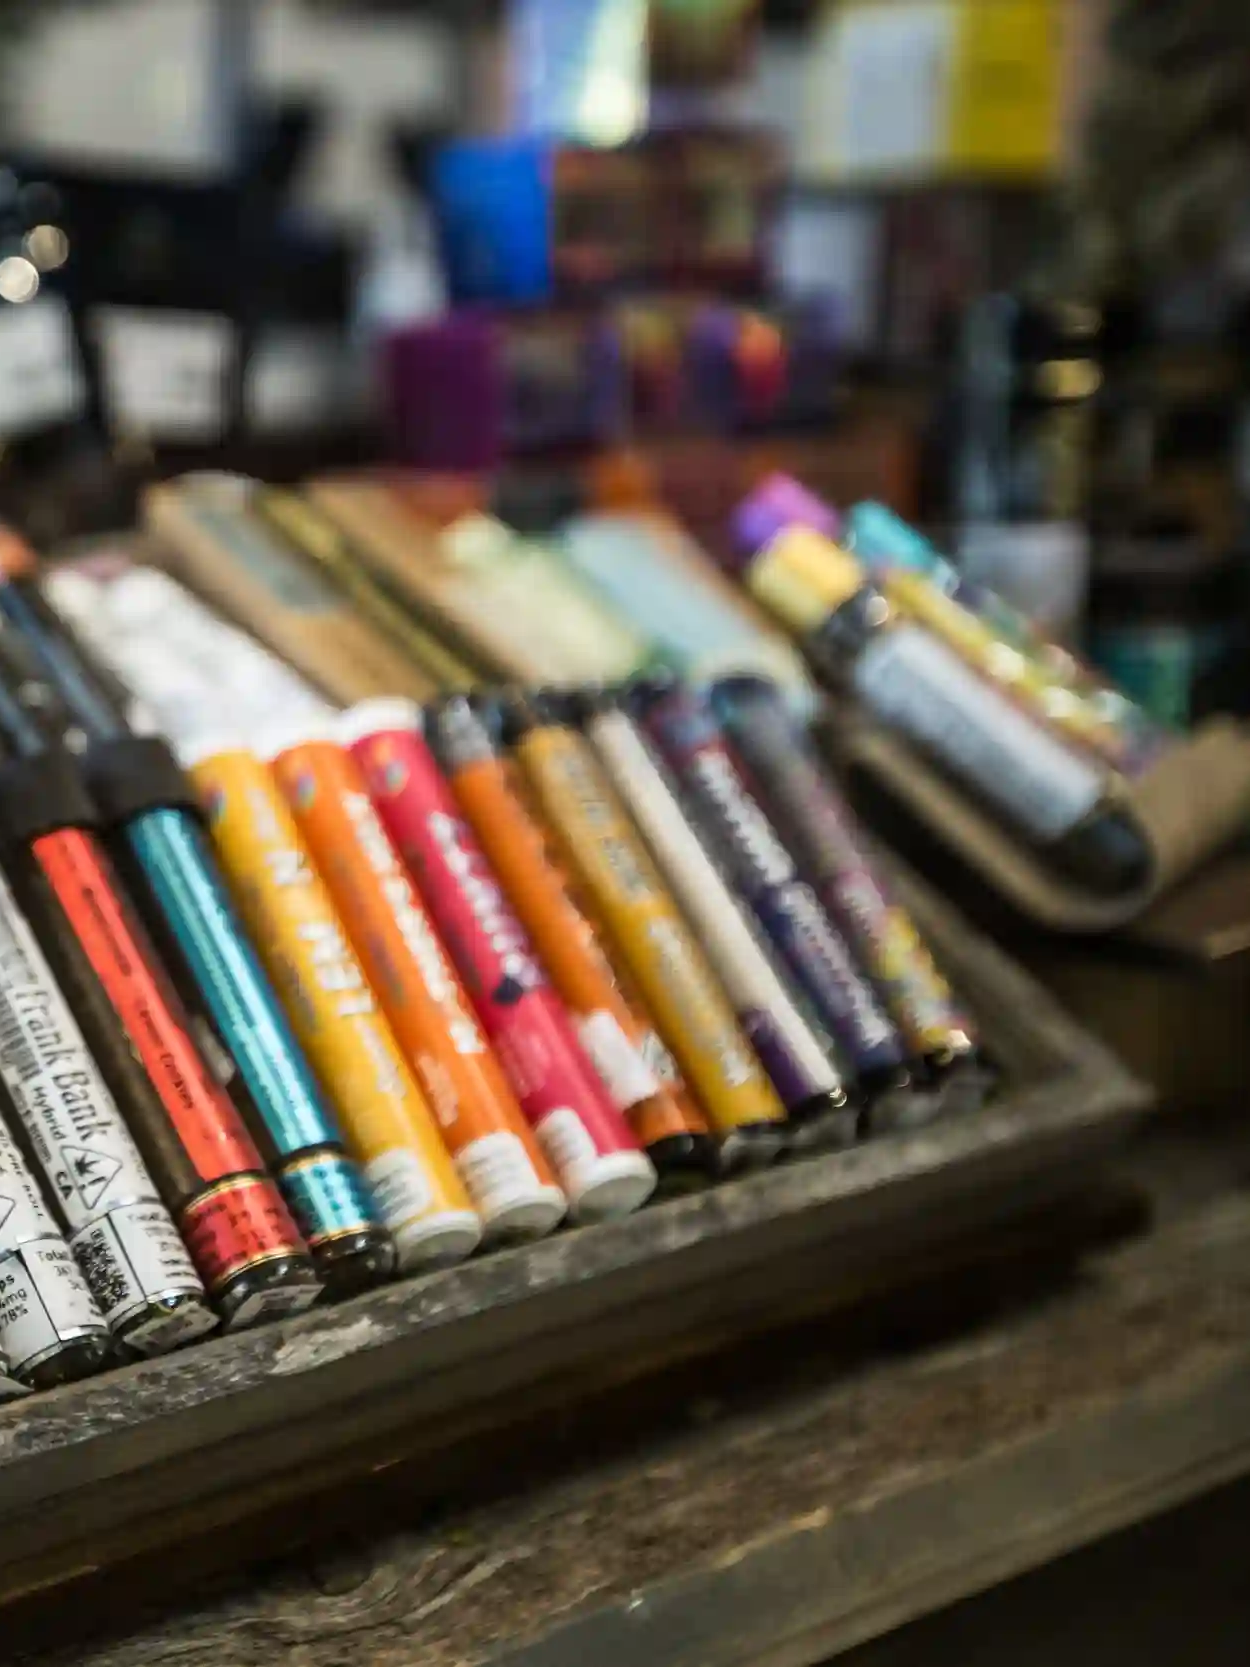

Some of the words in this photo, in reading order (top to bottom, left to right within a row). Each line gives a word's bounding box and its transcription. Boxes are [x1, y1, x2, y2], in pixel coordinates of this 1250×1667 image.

[16, 990, 75, 1065] Frank
[53, 1071, 111, 1140] Bank
[32, 1086, 65, 1140] Hybrid
[55, 1171, 73, 1199] CA
